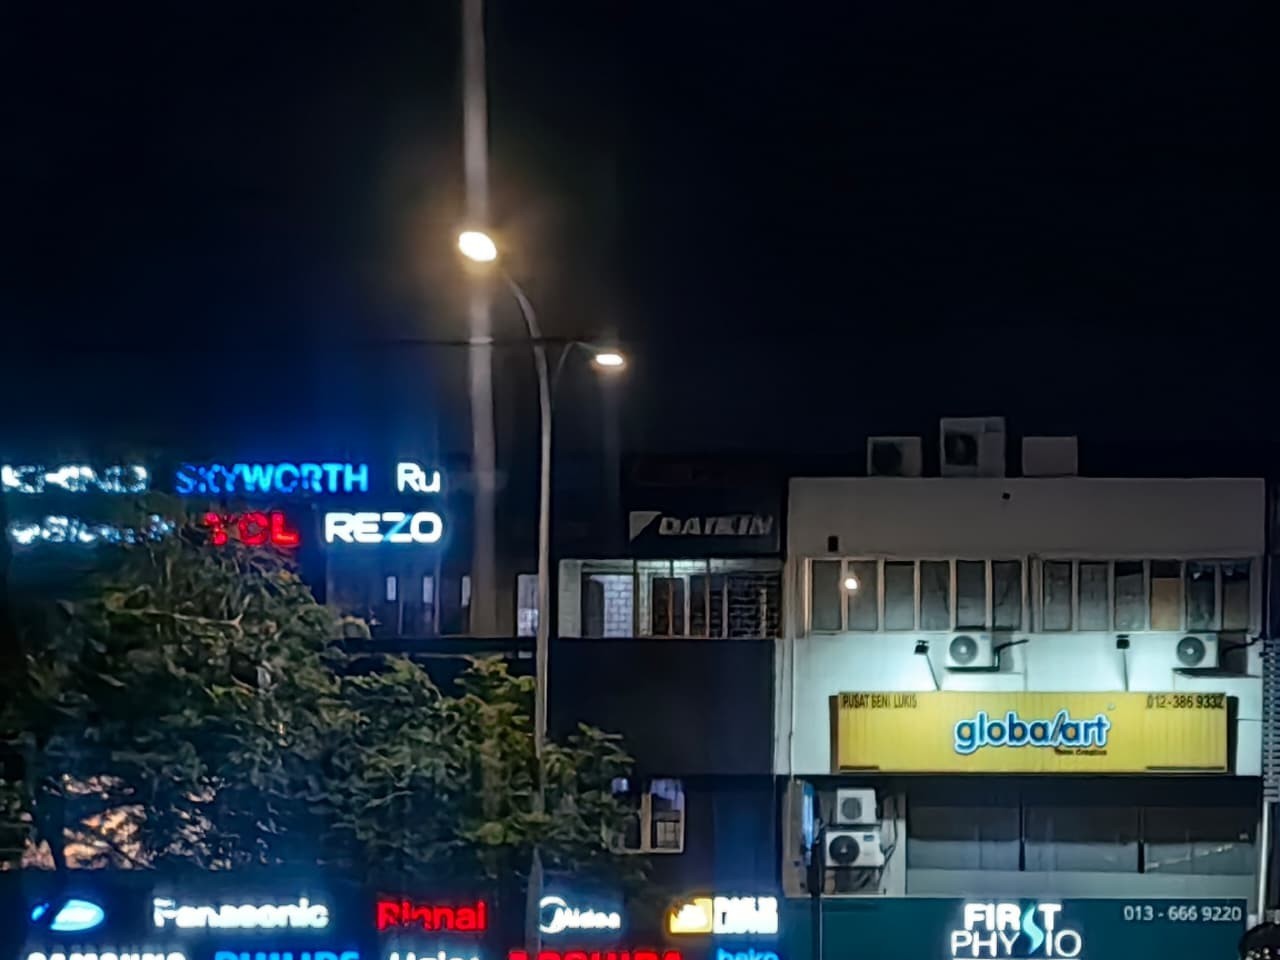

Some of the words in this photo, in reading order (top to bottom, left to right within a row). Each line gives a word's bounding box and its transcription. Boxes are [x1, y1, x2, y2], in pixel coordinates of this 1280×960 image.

[176, 464, 369, 493] SKYWORTH
[397, 463, 440, 493] Ru
[325, 511, 442, 543] REZO
[658, 515, 773, 536] DAIKIN
[376, 900, 486, 932] Rinnai
[963, 902, 1062, 932] FIRST
[1123, 905, 1154, 921] 013
[1167, 905, 1198, 921] 666
[1200, 905, 1242, 921] 9220
[950, 929, 1082, 958] PHYSIO
